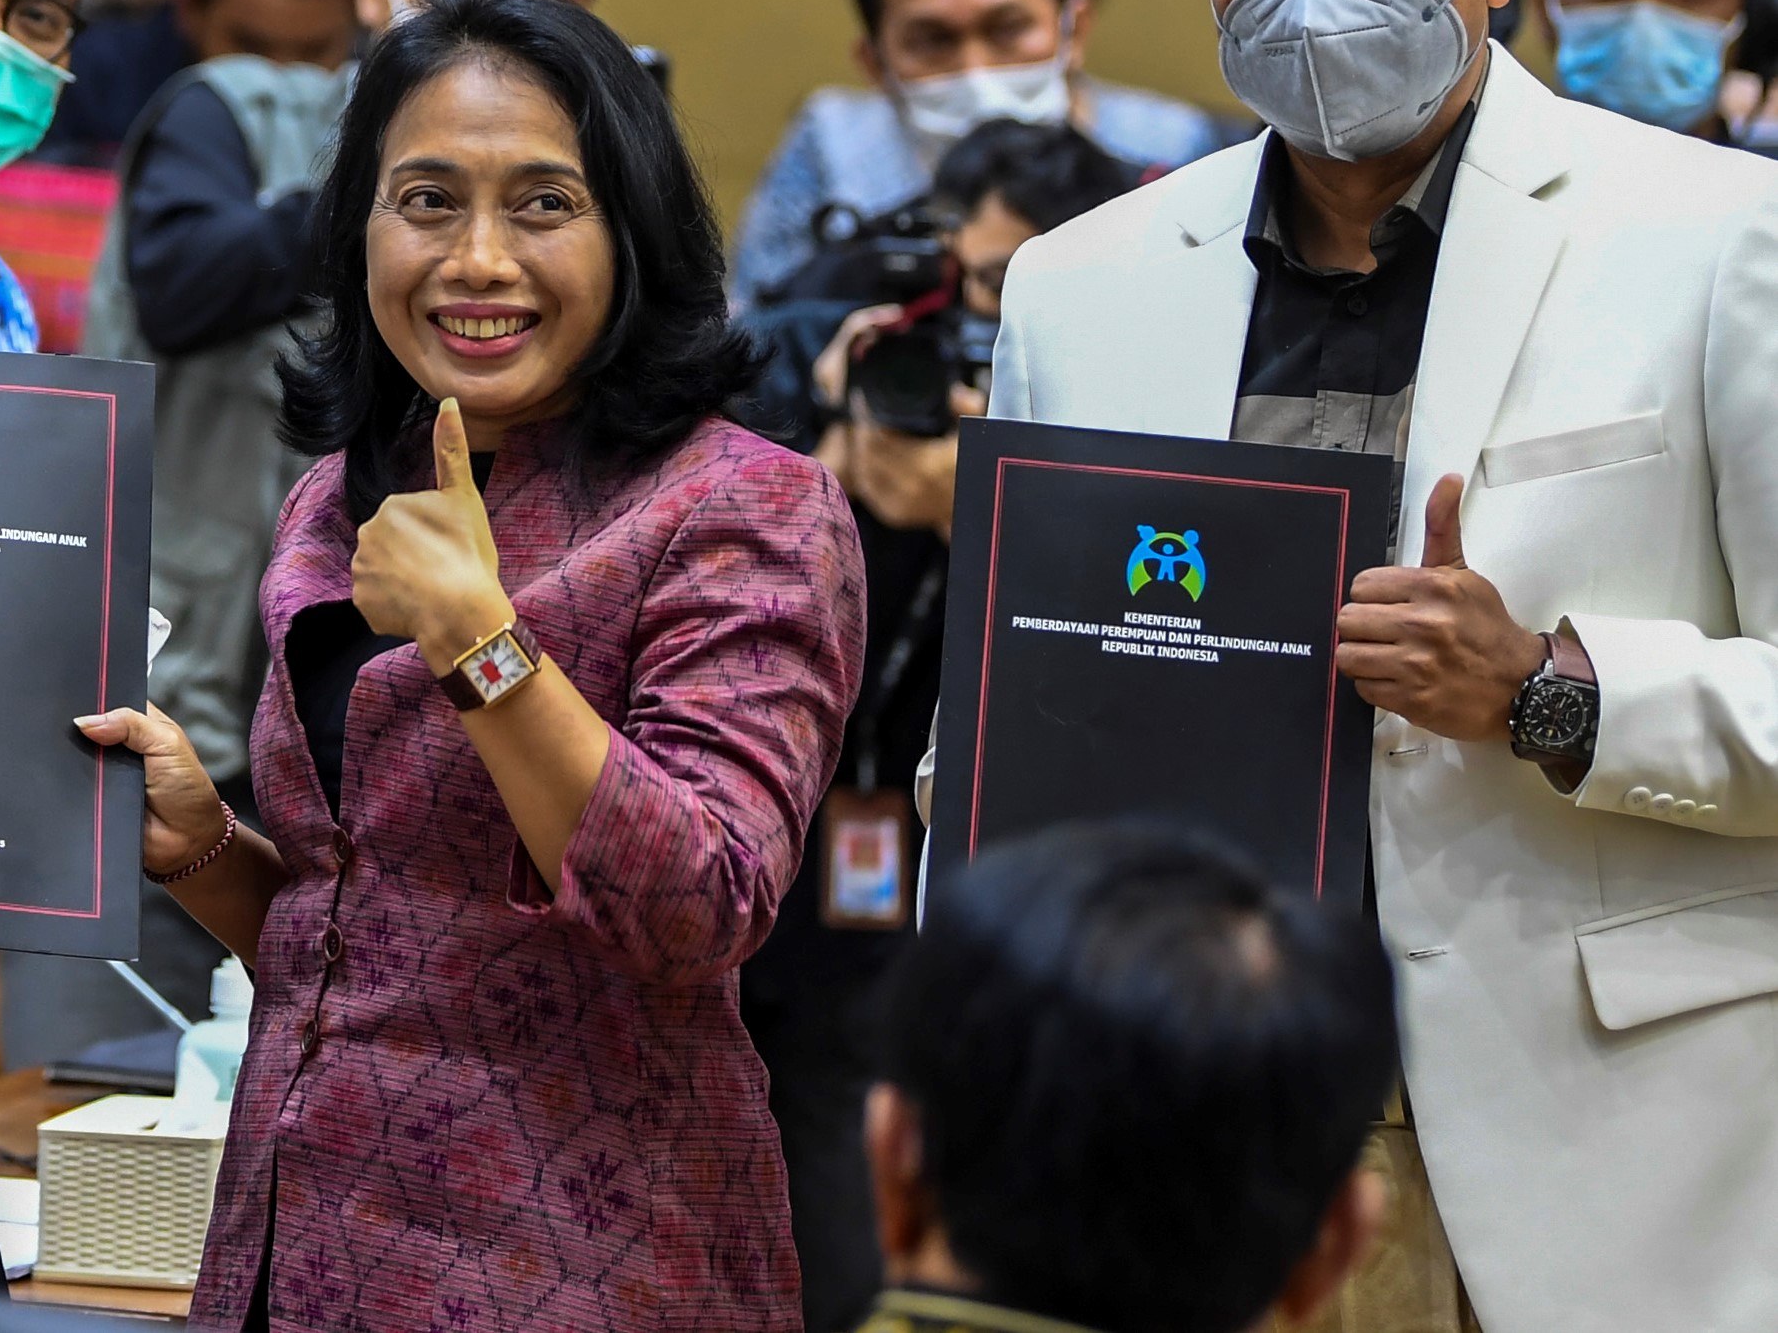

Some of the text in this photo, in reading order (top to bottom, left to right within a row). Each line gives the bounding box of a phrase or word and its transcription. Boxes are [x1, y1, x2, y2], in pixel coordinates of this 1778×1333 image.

[58, 534, 87, 547] ANAK
[1124, 611, 1201, 630] KEMENTERIAN
[1012, 616, 1312, 656] PEMBERDAYAAN PEREMPUAN DAN PERLINDUNGAN ANAK
[1102, 640, 1219, 663] REPUBLIK INDONESIA
